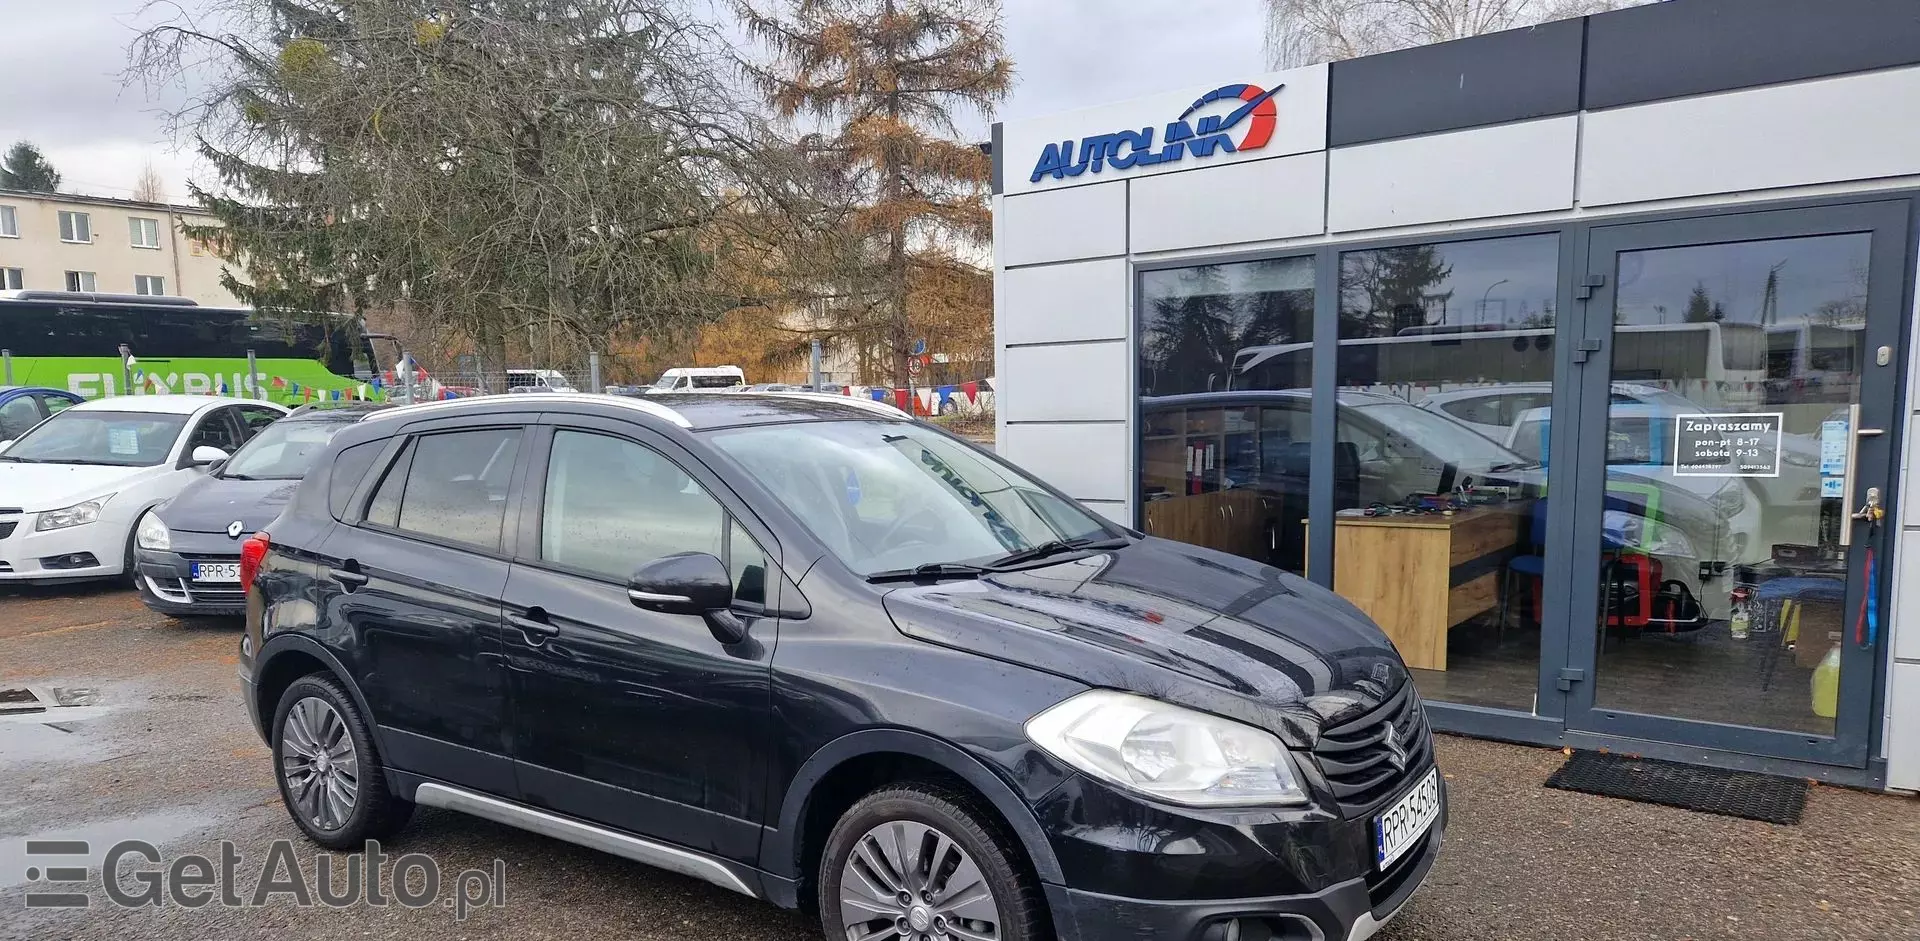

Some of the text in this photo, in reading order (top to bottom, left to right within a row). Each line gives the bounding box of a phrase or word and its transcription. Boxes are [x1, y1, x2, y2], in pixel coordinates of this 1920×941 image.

[1029, 114, 1239, 183] AUTOLINK
[1686, 420, 1772, 434] Zapraszamy
[1695, 437, 1760, 448] pon-pt 8-17
[1695, 448, 1759, 458] sobota 9-13
[199, 564, 224, 578] RPR
[1384, 804, 1408, 853] RPR
